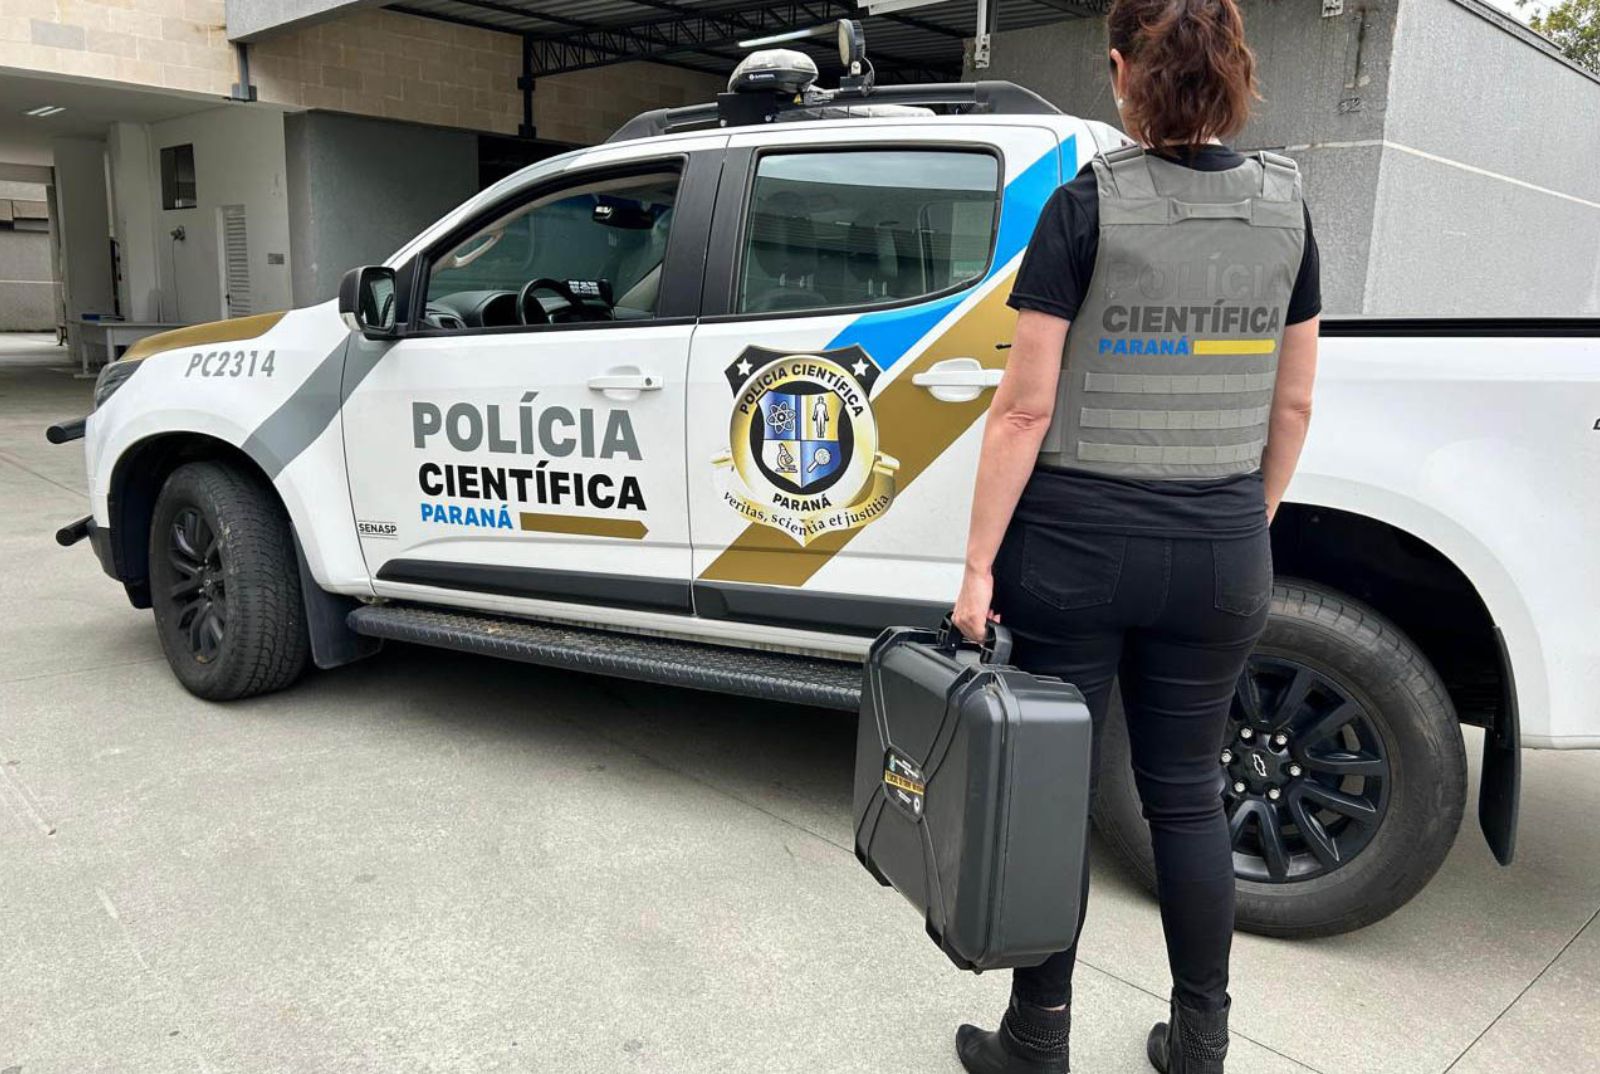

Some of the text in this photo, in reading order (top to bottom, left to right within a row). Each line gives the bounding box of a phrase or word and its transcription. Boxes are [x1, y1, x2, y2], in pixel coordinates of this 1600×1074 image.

[1102, 300, 1280, 333] CIENTÍFICA
[1099, 336, 1189, 355] PARANÁ
[184, 350, 276, 378] PC2314
[739, 364, 864, 417] POLÍCIA CIENTÍFICA
[412, 391, 643, 460] POLÍCIA
[418, 460, 647, 511] CIENTÍFICA
[420, 503, 513, 530] PARANÁ
[771, 514, 825, 536] scientia
[829, 515, 842, 527] et
[844, 494, 889, 528] justitia
[772, 493, 832, 512] PARANÁ
[358, 523, 397, 534] SENASP
